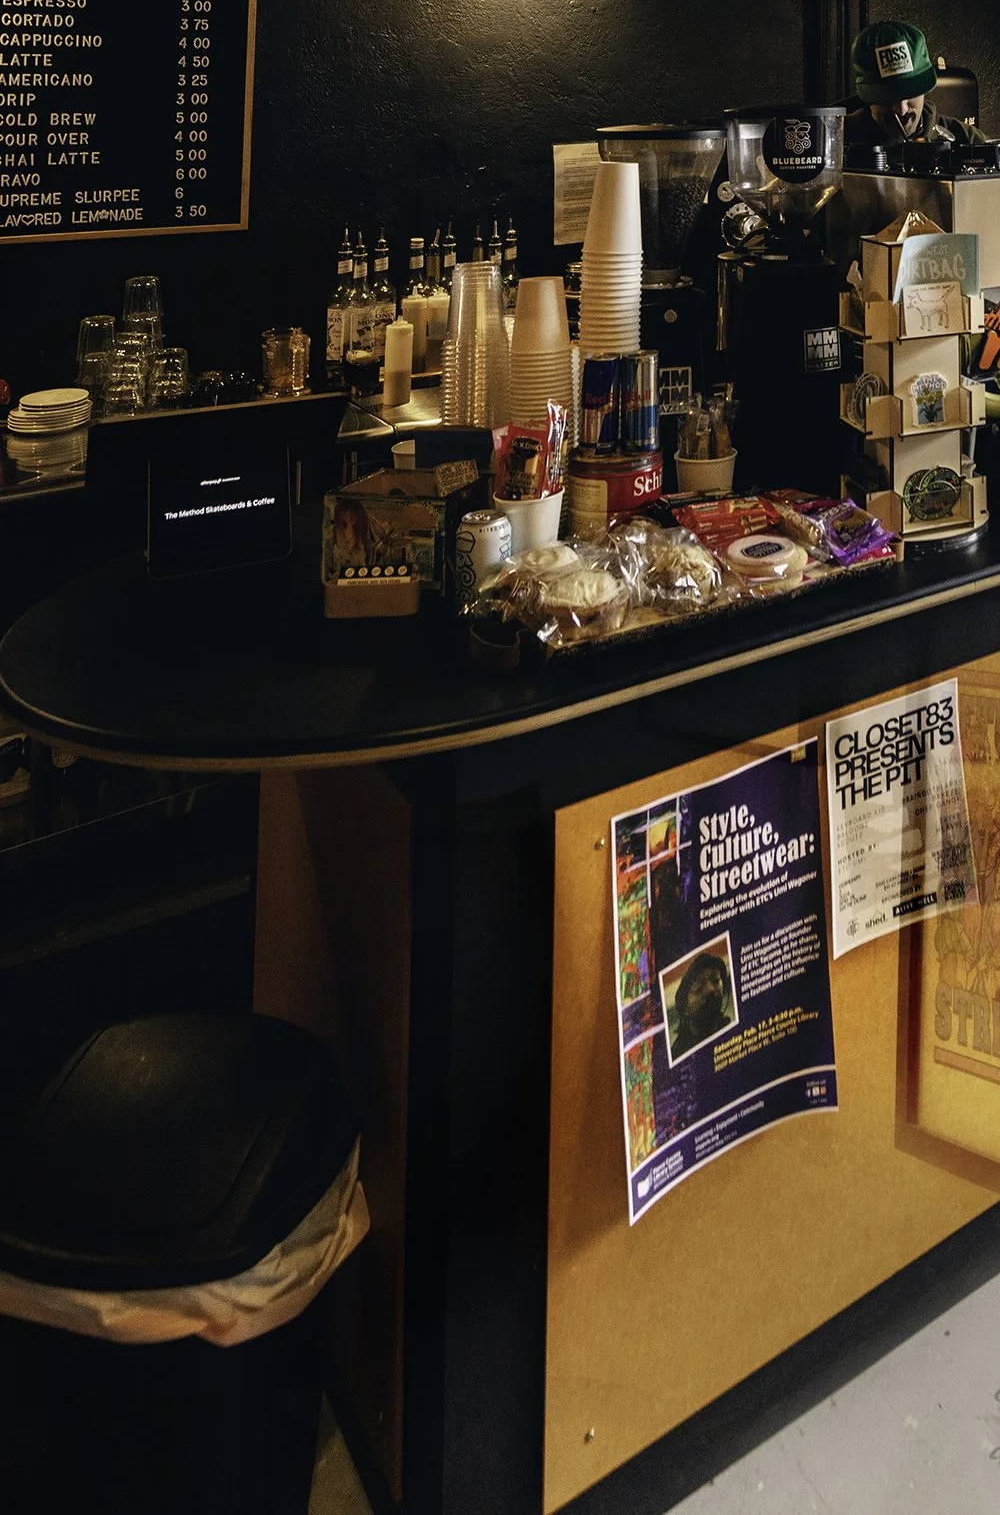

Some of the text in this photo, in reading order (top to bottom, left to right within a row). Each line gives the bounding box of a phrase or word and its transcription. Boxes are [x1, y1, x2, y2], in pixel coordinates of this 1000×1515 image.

[181, 0, 190, 12] 3
[194, 0, 212, 12] 00
[1, 14, 209, 31] CORTADO 3 75
[0, 34, 210, 49] CAPPUCCINO 4 00
[0, 54, 210, 68] LATTE 4 50
[880, 46, 907, 68] FOSS
[0, 73, 208, 86] AMERICANO 3 25
[176, 93, 185, 105] 3
[191, 93, 208, 105] 00
[50, 113, 96, 126] BREW
[176, 112, 184, 124] 5
[190, 112, 208, 124] 00
[47, 132, 89, 145] OVER
[174, 131, 183, 142] 4
[189, 130, 208, 142] 00
[0, 149, 207, 166] HAI LATTE 5 00
[772, 156, 822, 165] BLUEBEARD
[0, 168, 207, 187] RAVO 6 00
[0, 187, 184, 208] UPREME SLURPEE 6
[175, 206, 183, 218] 3
[189, 205, 207, 217] 50
[900, 253, 967, 281] DIRTBAG
[806, 329, 838, 345] MM
[912, 381, 948, 393] METHOD
[164, 496, 275, 521] The Method Skateboards & Coffee
[834, 696, 954, 760] CLOSET83
[834, 721, 955, 786] PRESENTS
[835, 772, 883, 810] THE
[885, 754, 926, 793] PIT
[699, 803, 756, 845] Style,
[699, 821, 800, 874] Culture,
[699, 833, 816, 904] Streetwear:
[700, 870, 789, 920] Exploring the evolution of
[700, 870, 818, 931] streetwear with ETC's Umi Wagoner
[865, 913, 888, 930] shed.
